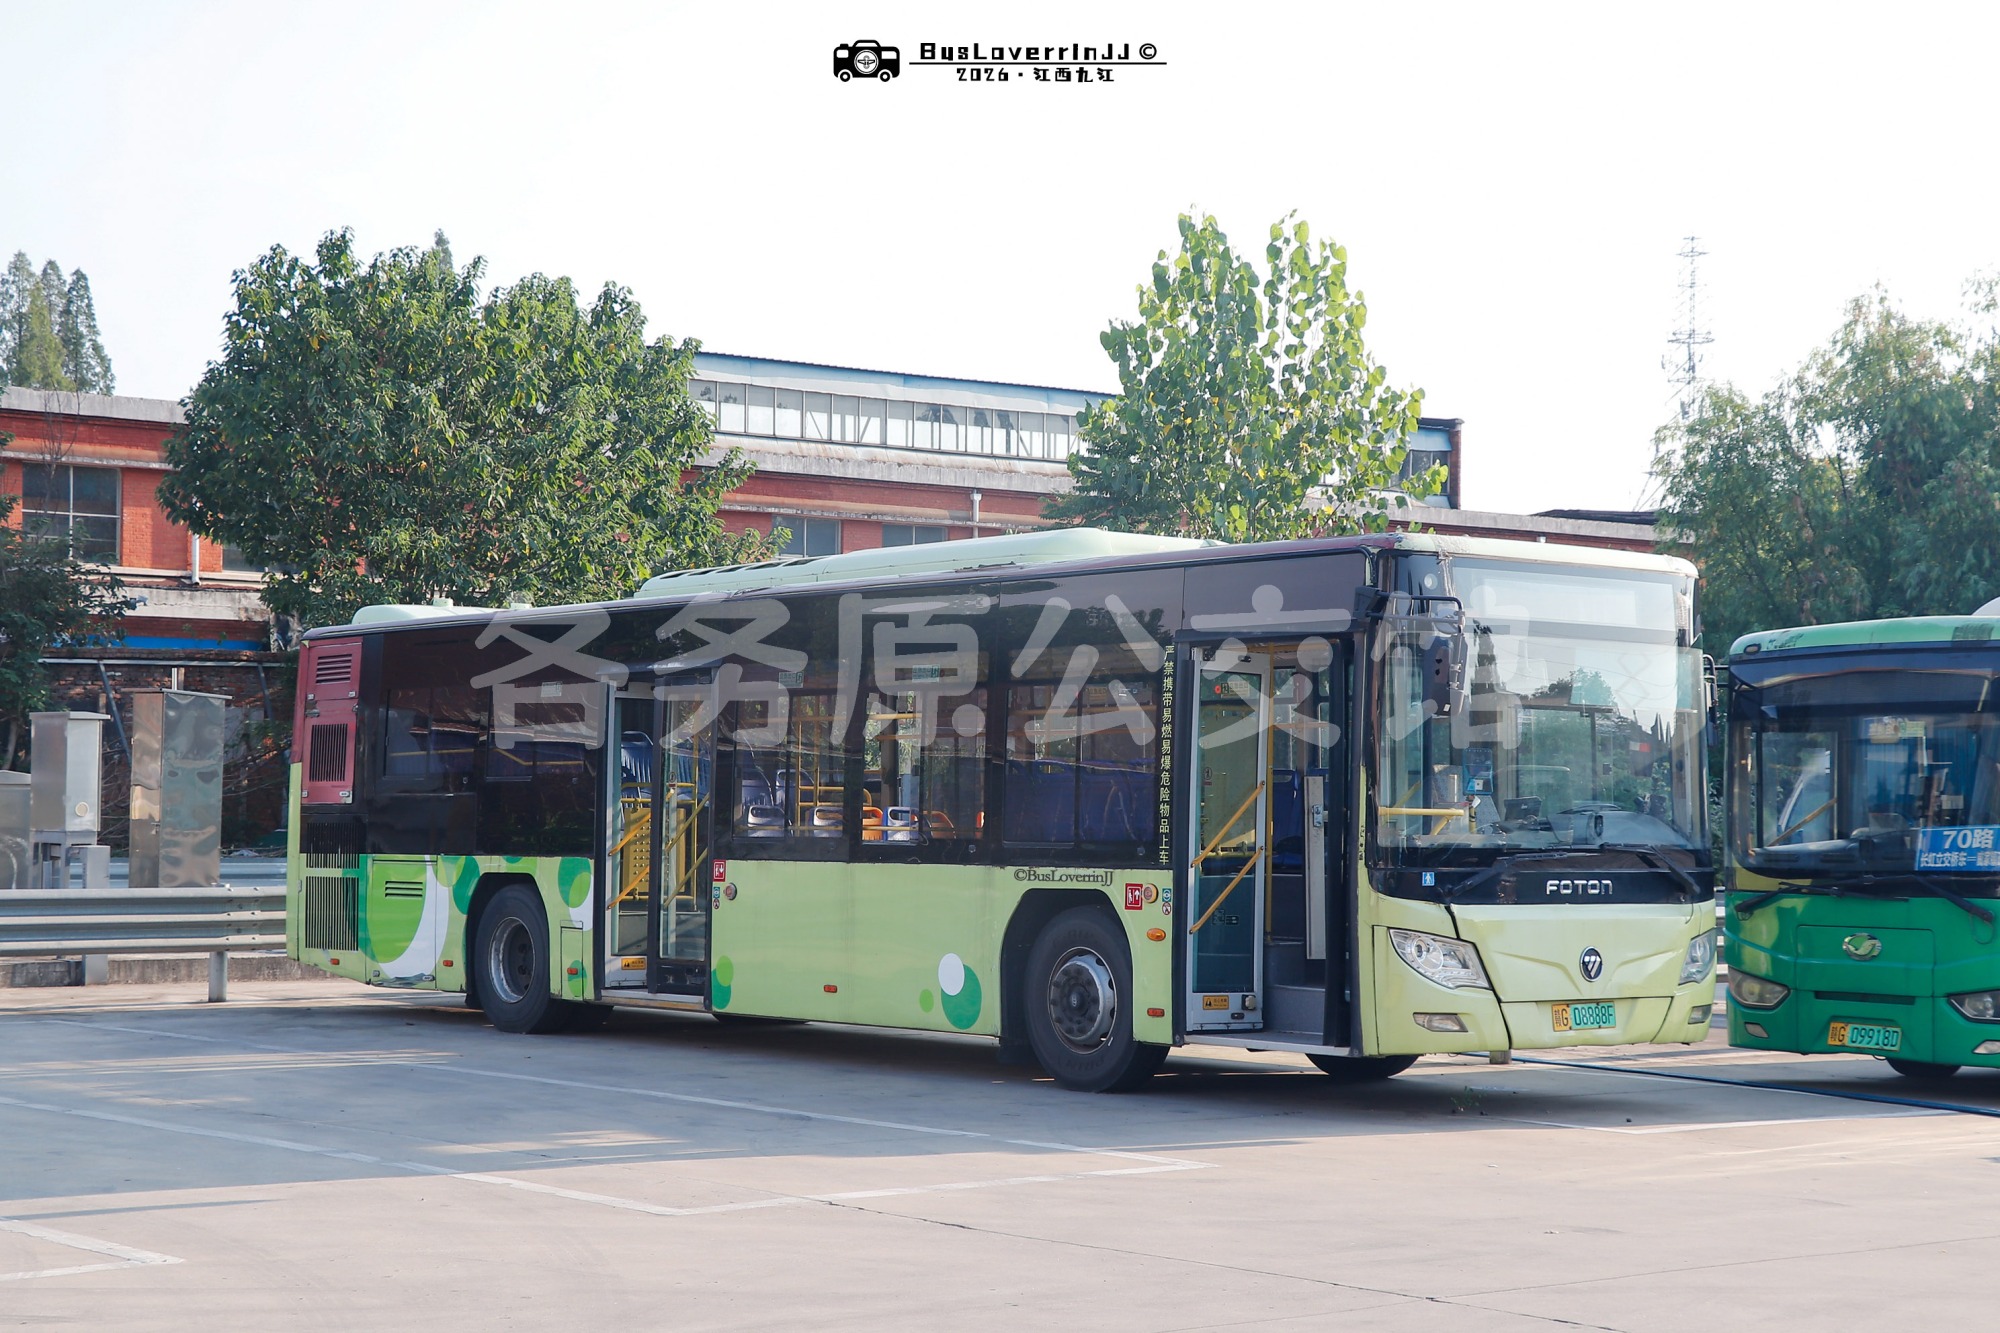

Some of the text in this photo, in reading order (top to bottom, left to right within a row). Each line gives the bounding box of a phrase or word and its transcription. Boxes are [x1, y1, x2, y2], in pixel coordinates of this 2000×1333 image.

[1158, 645, 1175, 865] 严禁携带易燃易爆危险物品上车
[1943, 828, 1994, 849] 70路
[1545, 879, 1614, 895] FOTON
